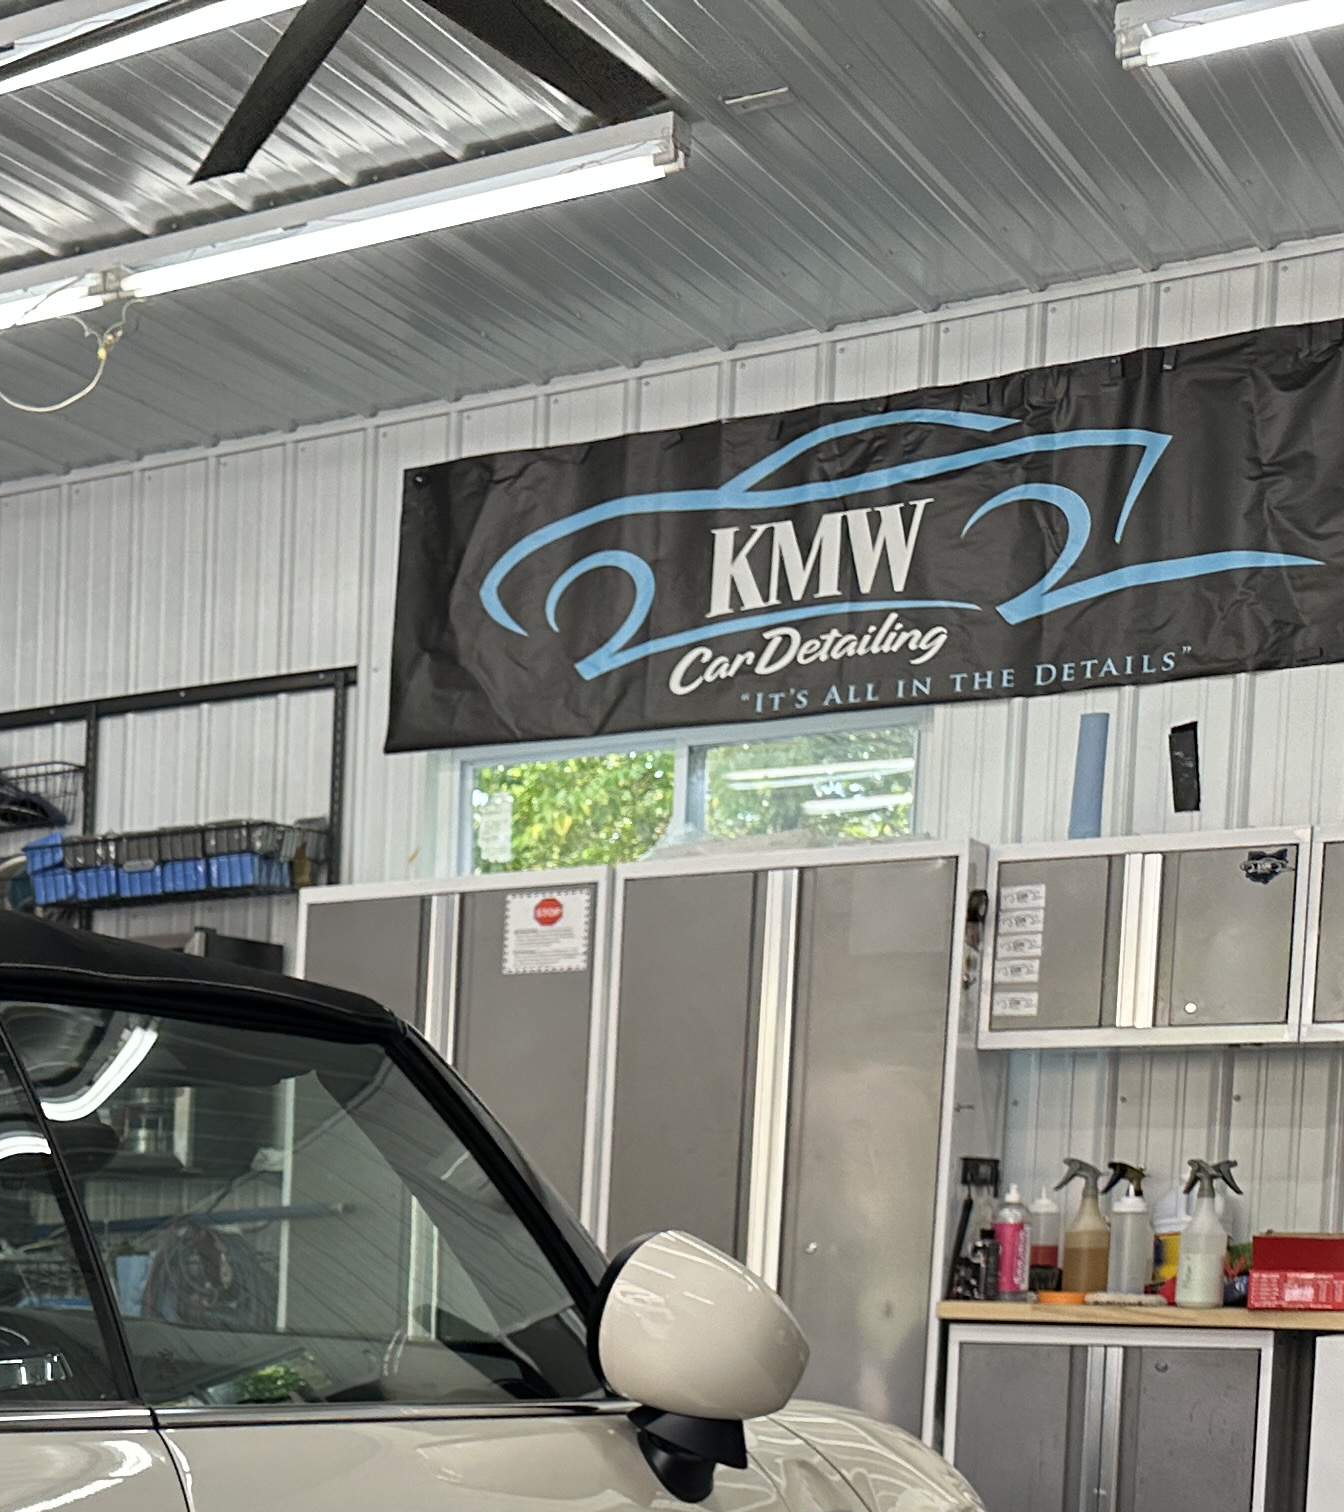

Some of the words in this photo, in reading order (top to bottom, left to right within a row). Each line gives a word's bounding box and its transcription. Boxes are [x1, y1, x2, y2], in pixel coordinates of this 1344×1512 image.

[705, 497, 935, 619] KMW
[668, 645, 755, 697] Car
[756, 611, 949, 677] Detailing
[823, 681, 880, 707] ALL
[896, 675, 932, 699] IN
[949, 667, 1016, 692] THE
